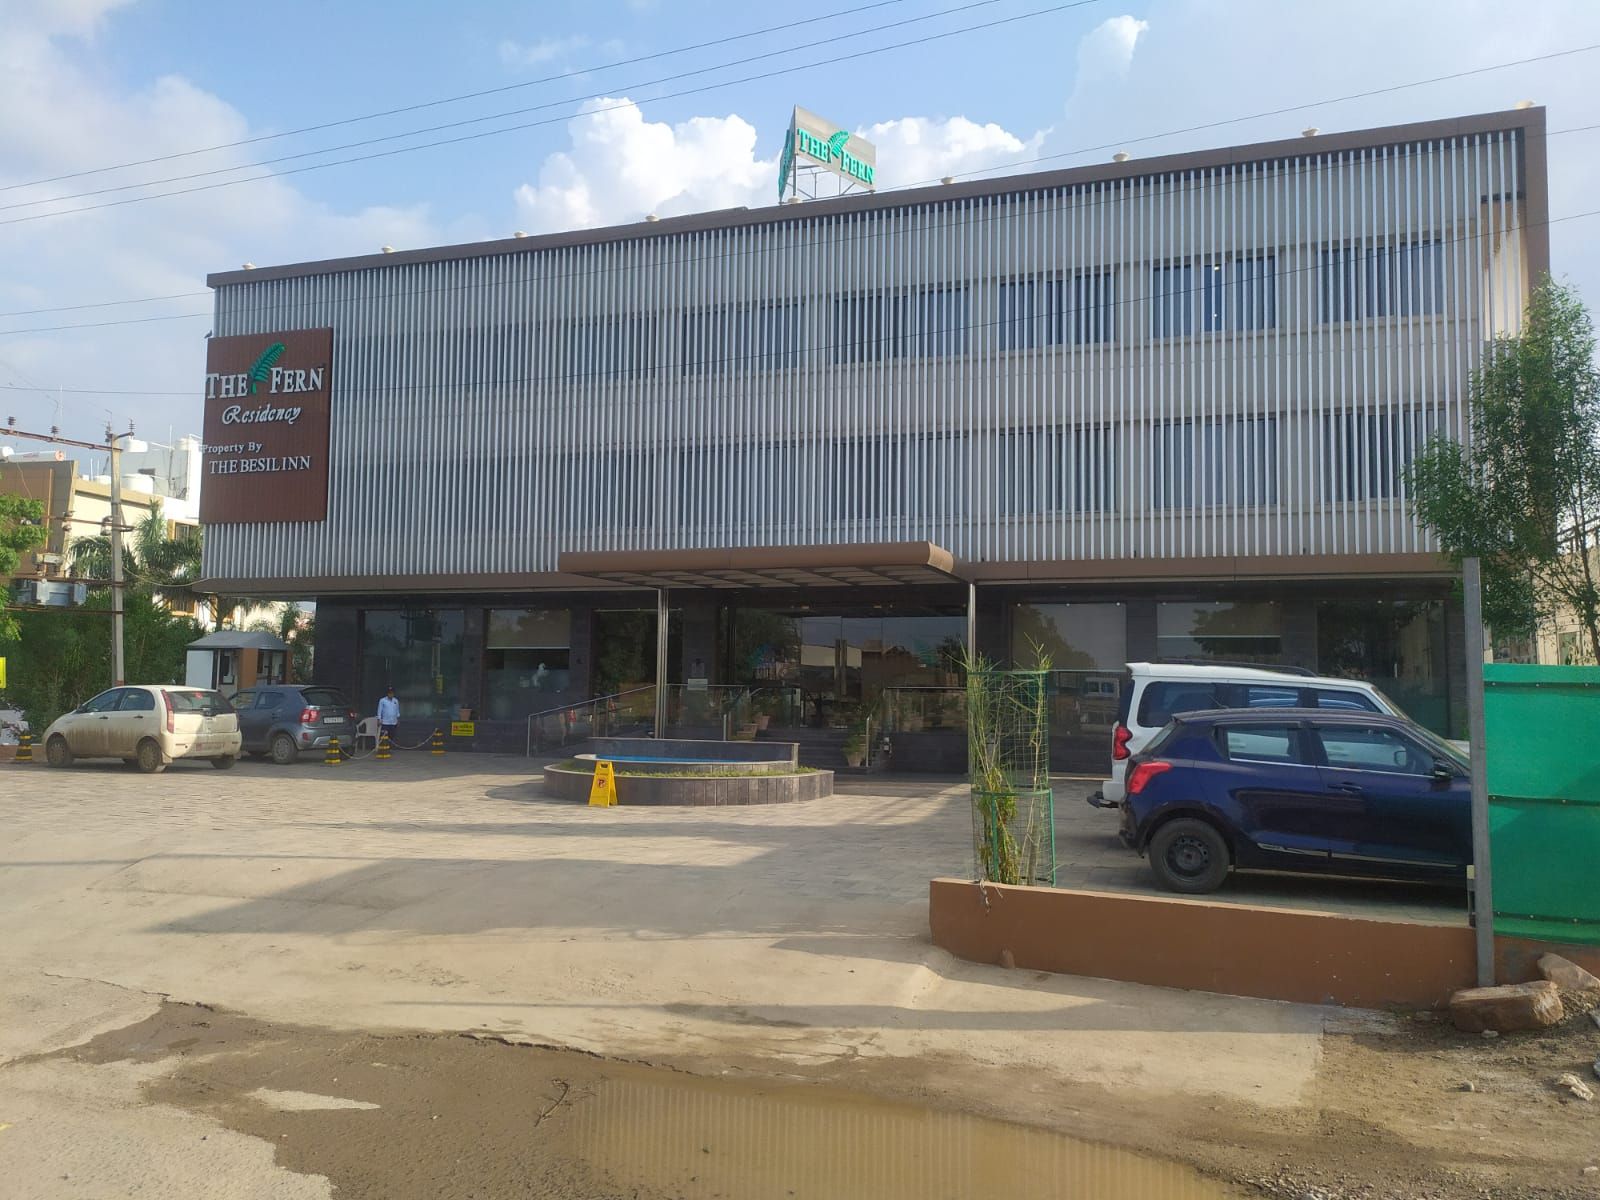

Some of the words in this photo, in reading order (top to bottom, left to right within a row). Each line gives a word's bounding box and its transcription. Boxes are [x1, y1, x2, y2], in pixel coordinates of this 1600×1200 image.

[797, 128, 829, 163] THE
[840, 150, 876, 185] FERN
[206, 373, 248, 399] THE
[269, 367, 325, 394] FERN
[222, 403, 301, 425] Residency
[199, 442, 244, 455] Property
[248, 441, 263, 454] By
[208, 459, 238, 474] THE
[239, 457, 280, 473] BESIL
[280, 455, 310, 471] INN
